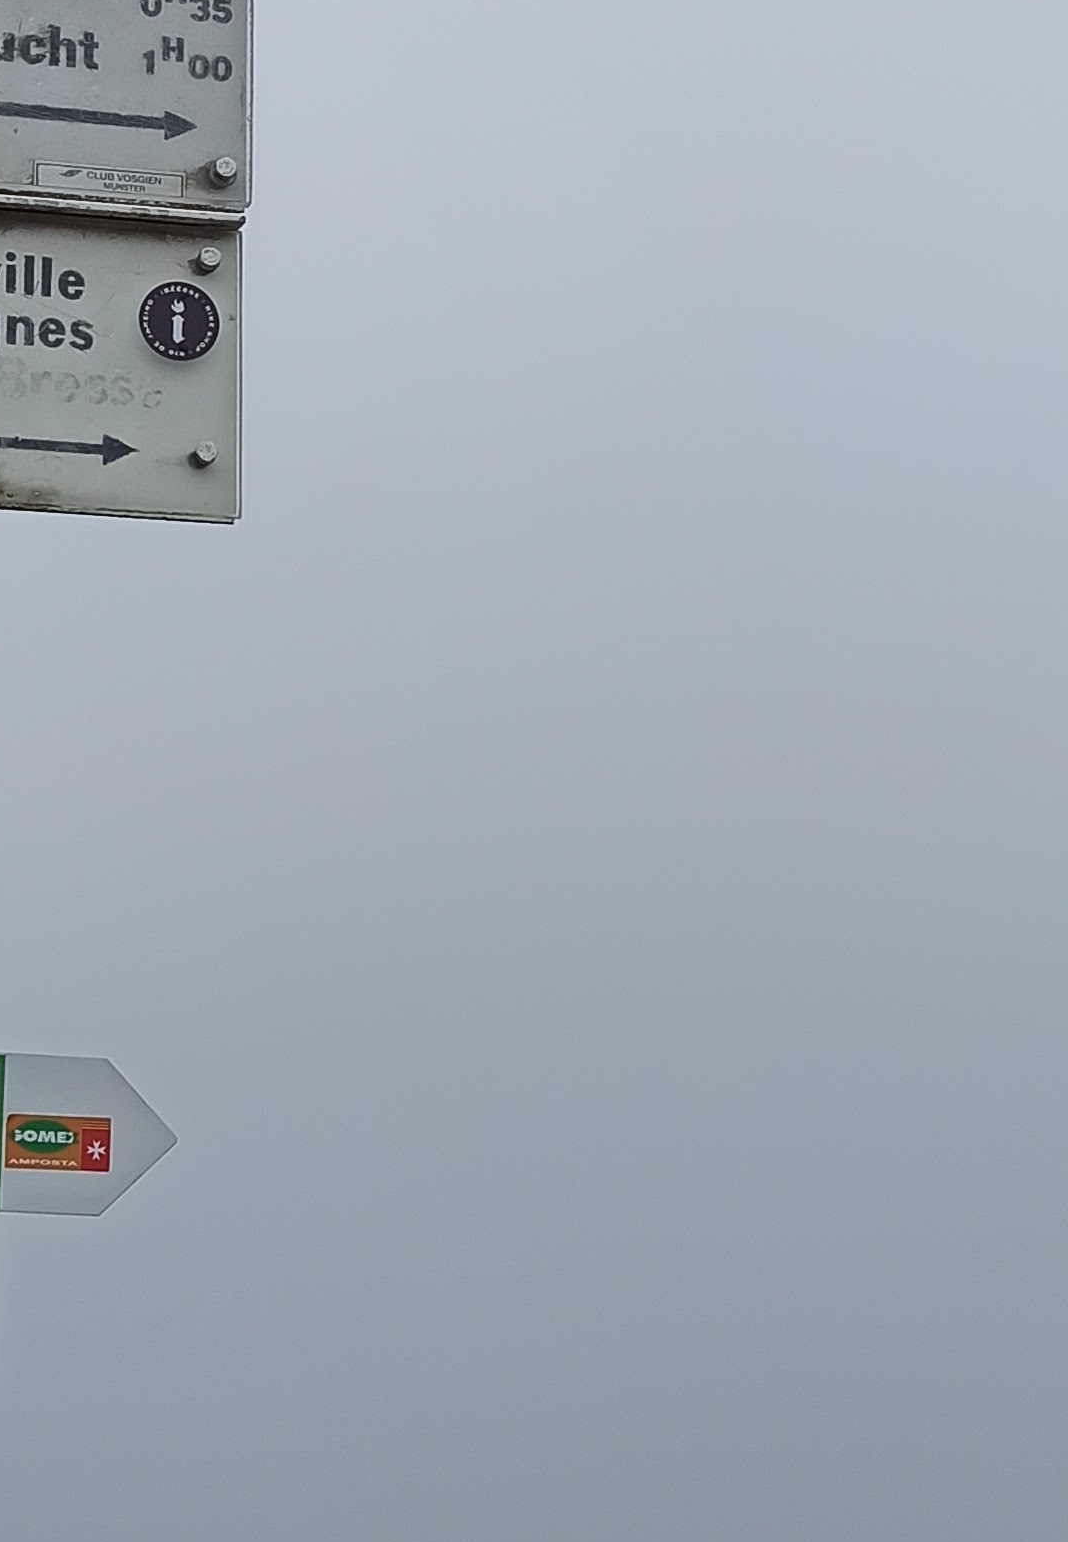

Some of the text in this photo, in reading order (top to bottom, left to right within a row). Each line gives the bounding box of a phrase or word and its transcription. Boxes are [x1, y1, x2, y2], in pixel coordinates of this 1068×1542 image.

[86, 171, 162, 186] CLUB VOSGIEN
[103, 182, 146, 193] MUNSTER
